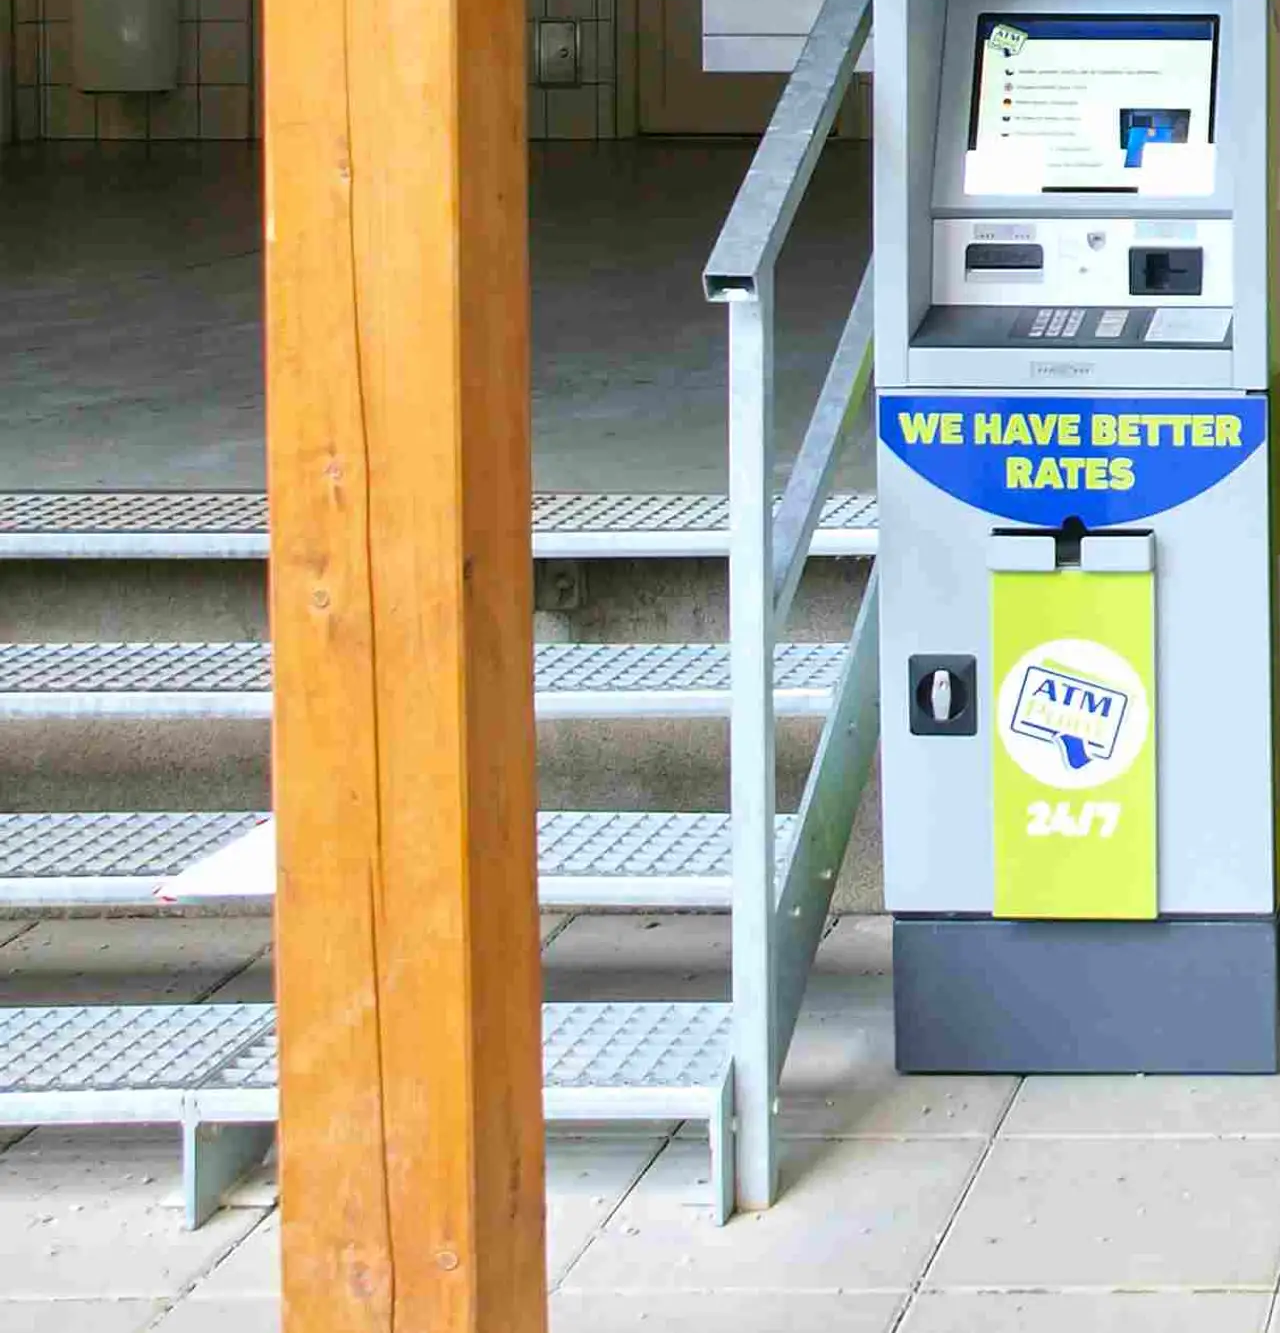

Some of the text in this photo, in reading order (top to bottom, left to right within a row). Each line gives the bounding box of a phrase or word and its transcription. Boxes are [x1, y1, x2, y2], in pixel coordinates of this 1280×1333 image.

[898, 412, 1242, 447] WE HAVE BETTER
[1006, 456, 1135, 490] RATES
[1032, 679, 1112, 717] ATM
[1026, 801, 1122, 837] 24/7
